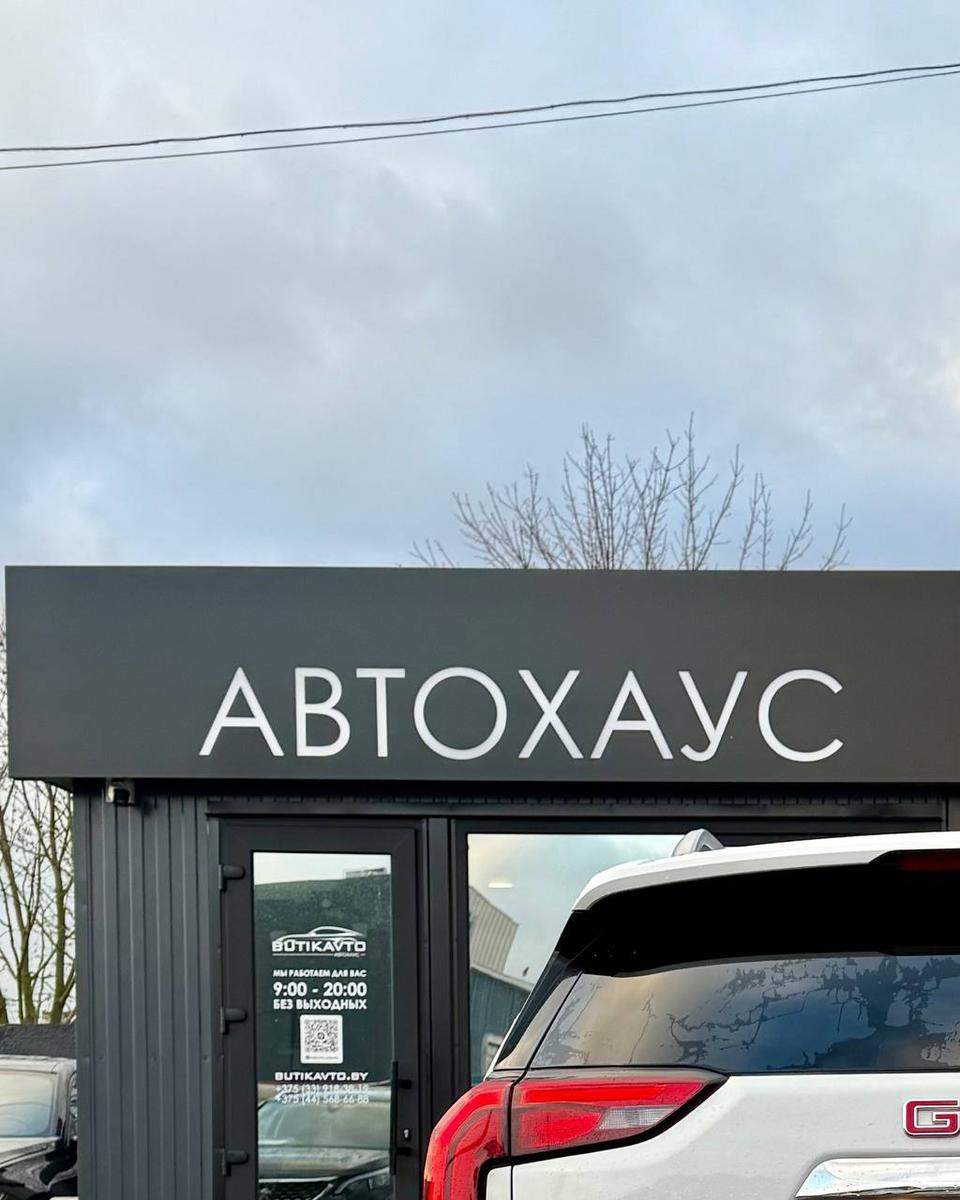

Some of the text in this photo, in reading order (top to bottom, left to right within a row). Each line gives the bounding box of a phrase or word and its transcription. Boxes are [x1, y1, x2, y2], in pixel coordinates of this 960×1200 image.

[199, 666, 844, 762] АВТОХАУС
[272, 940, 366, 952] BUTIKAVTO
[331, 970, 348, 978] ДЛЯ
[273, 982, 307, 996] 9:00
[323, 982, 367, 996] 20:00
[273, 999, 367, 1011] БЕЗ ВЫХОДНЫХ
[275, 1072, 368, 1081] BUTIKAVTO.BY
